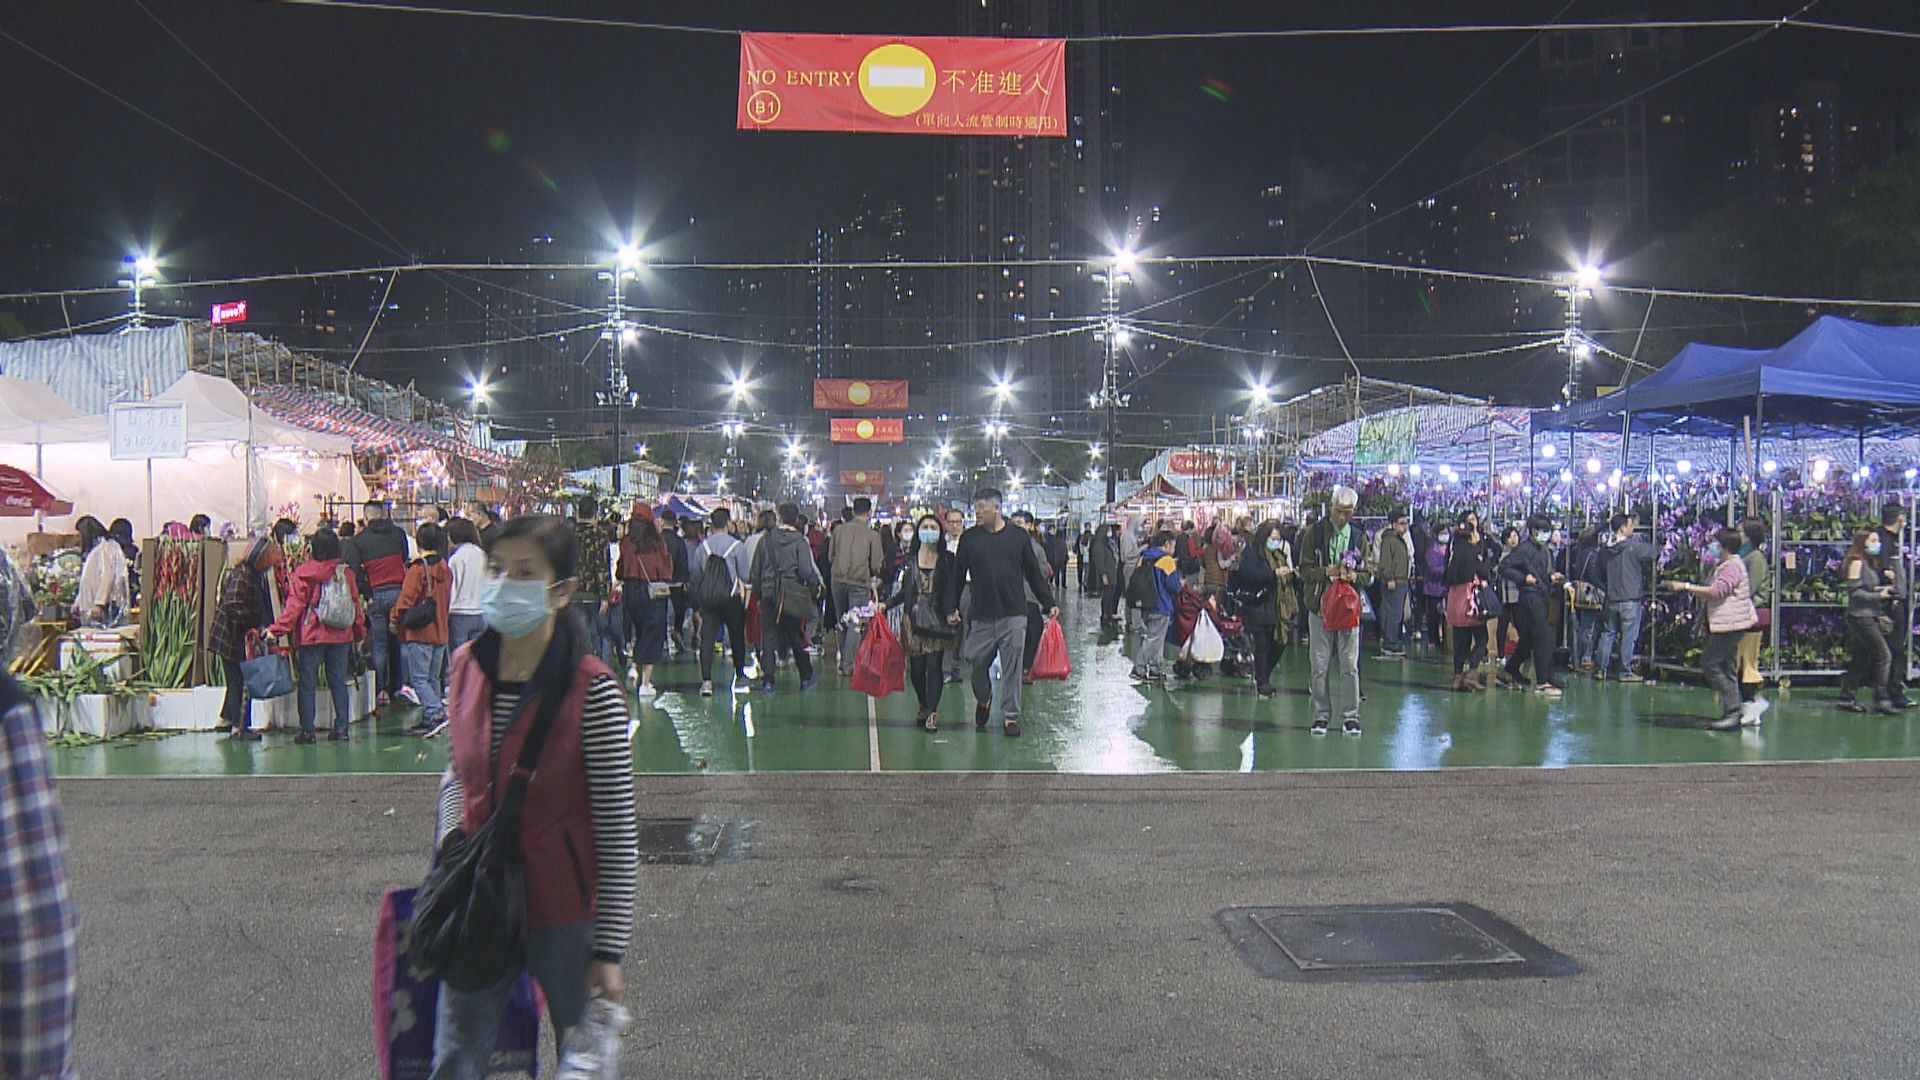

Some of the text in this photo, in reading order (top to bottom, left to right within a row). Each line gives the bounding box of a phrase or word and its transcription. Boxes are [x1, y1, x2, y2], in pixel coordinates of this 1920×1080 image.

[747, 70, 855, 87] NO ENTRY
[755, 100, 774, 115] B1
